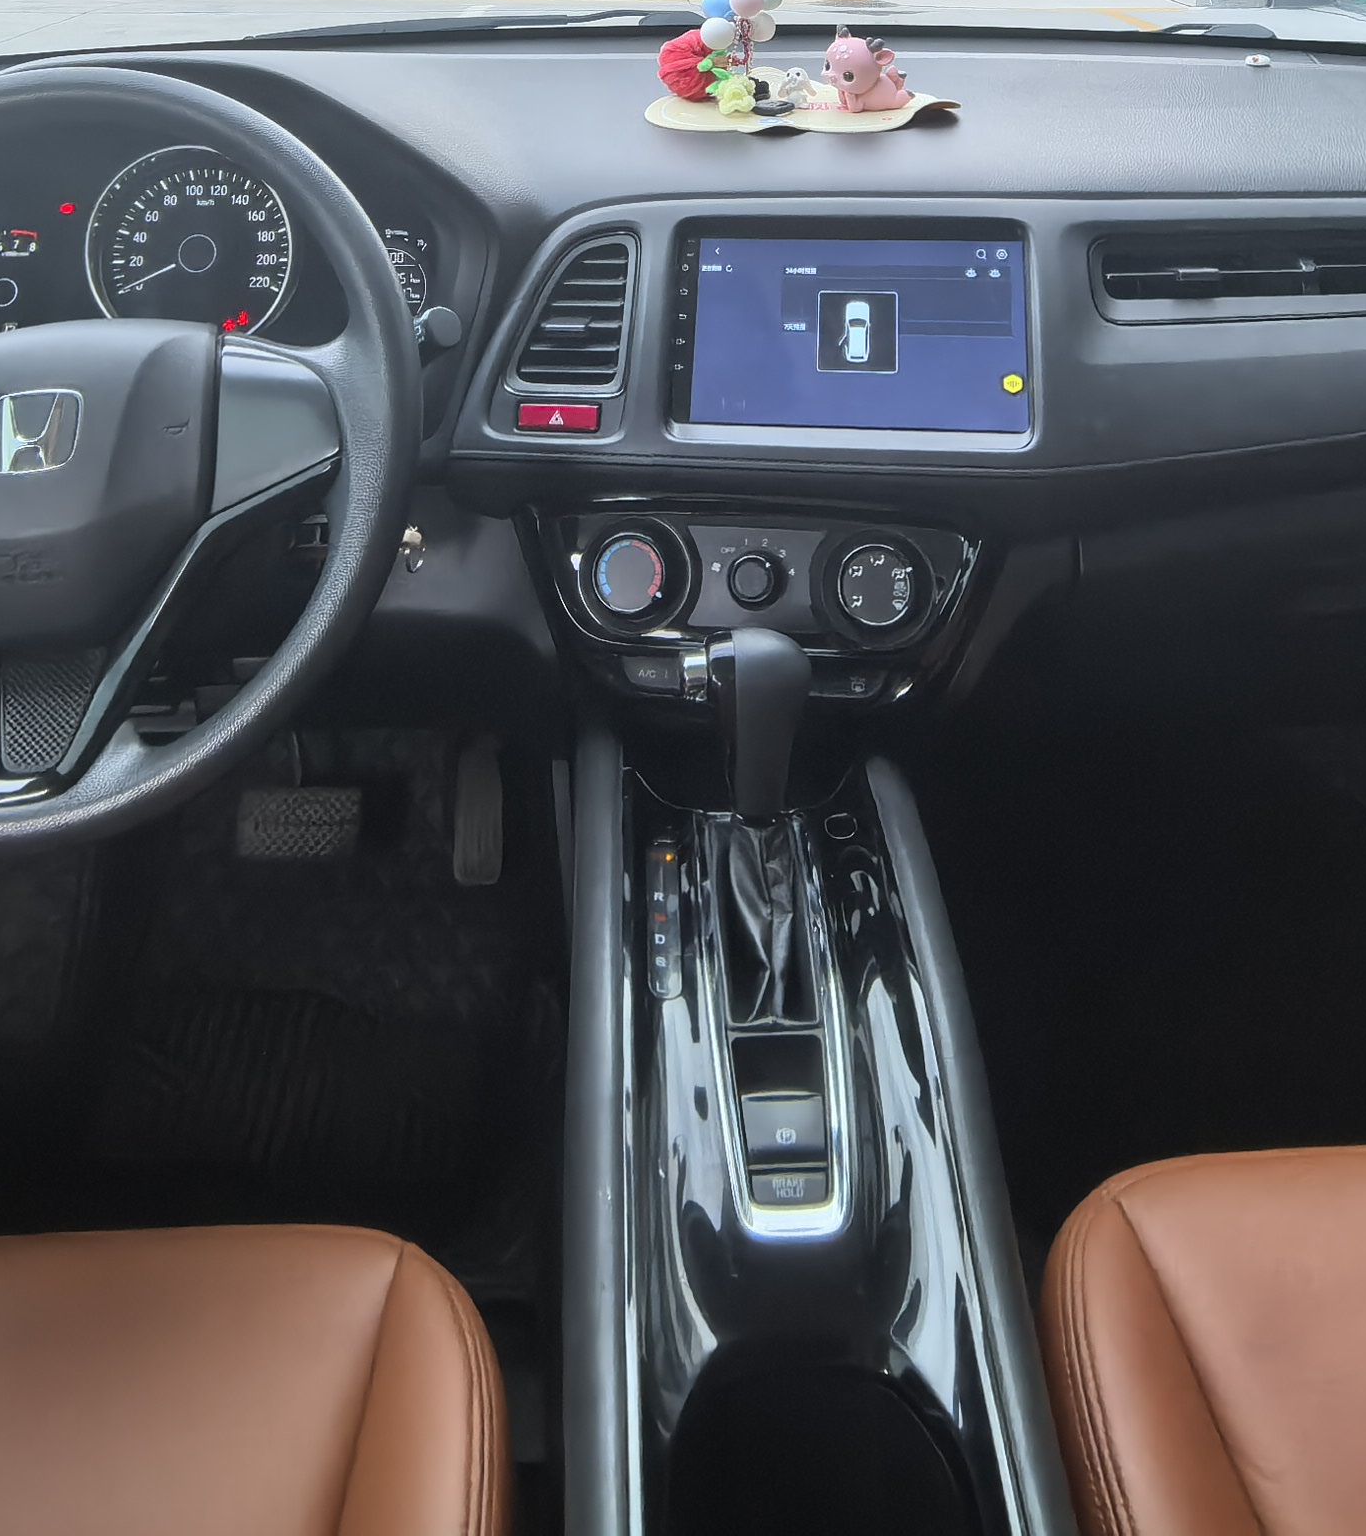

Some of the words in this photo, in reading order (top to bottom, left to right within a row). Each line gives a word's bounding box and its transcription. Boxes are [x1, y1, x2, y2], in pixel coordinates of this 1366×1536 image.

[186, 185, 204, 195] 100
[210, 185, 228, 195] 120
[163, 195, 177, 206] 80
[231, 195, 249, 205] 140
[145, 211, 159, 222] 60
[248, 211, 265, 221] 160
[133, 232, 147, 243] 40
[257, 231, 275, 242] 180
[129, 256, 143, 266] 20
[256, 254, 276, 264] 200
[249, 277, 270, 287] 220
[638, 668, 657, 679] A/C
[653, 891, 665, 902] R
[654, 933, 666, 945] D
[776, 1187, 805, 1198] HOLD
